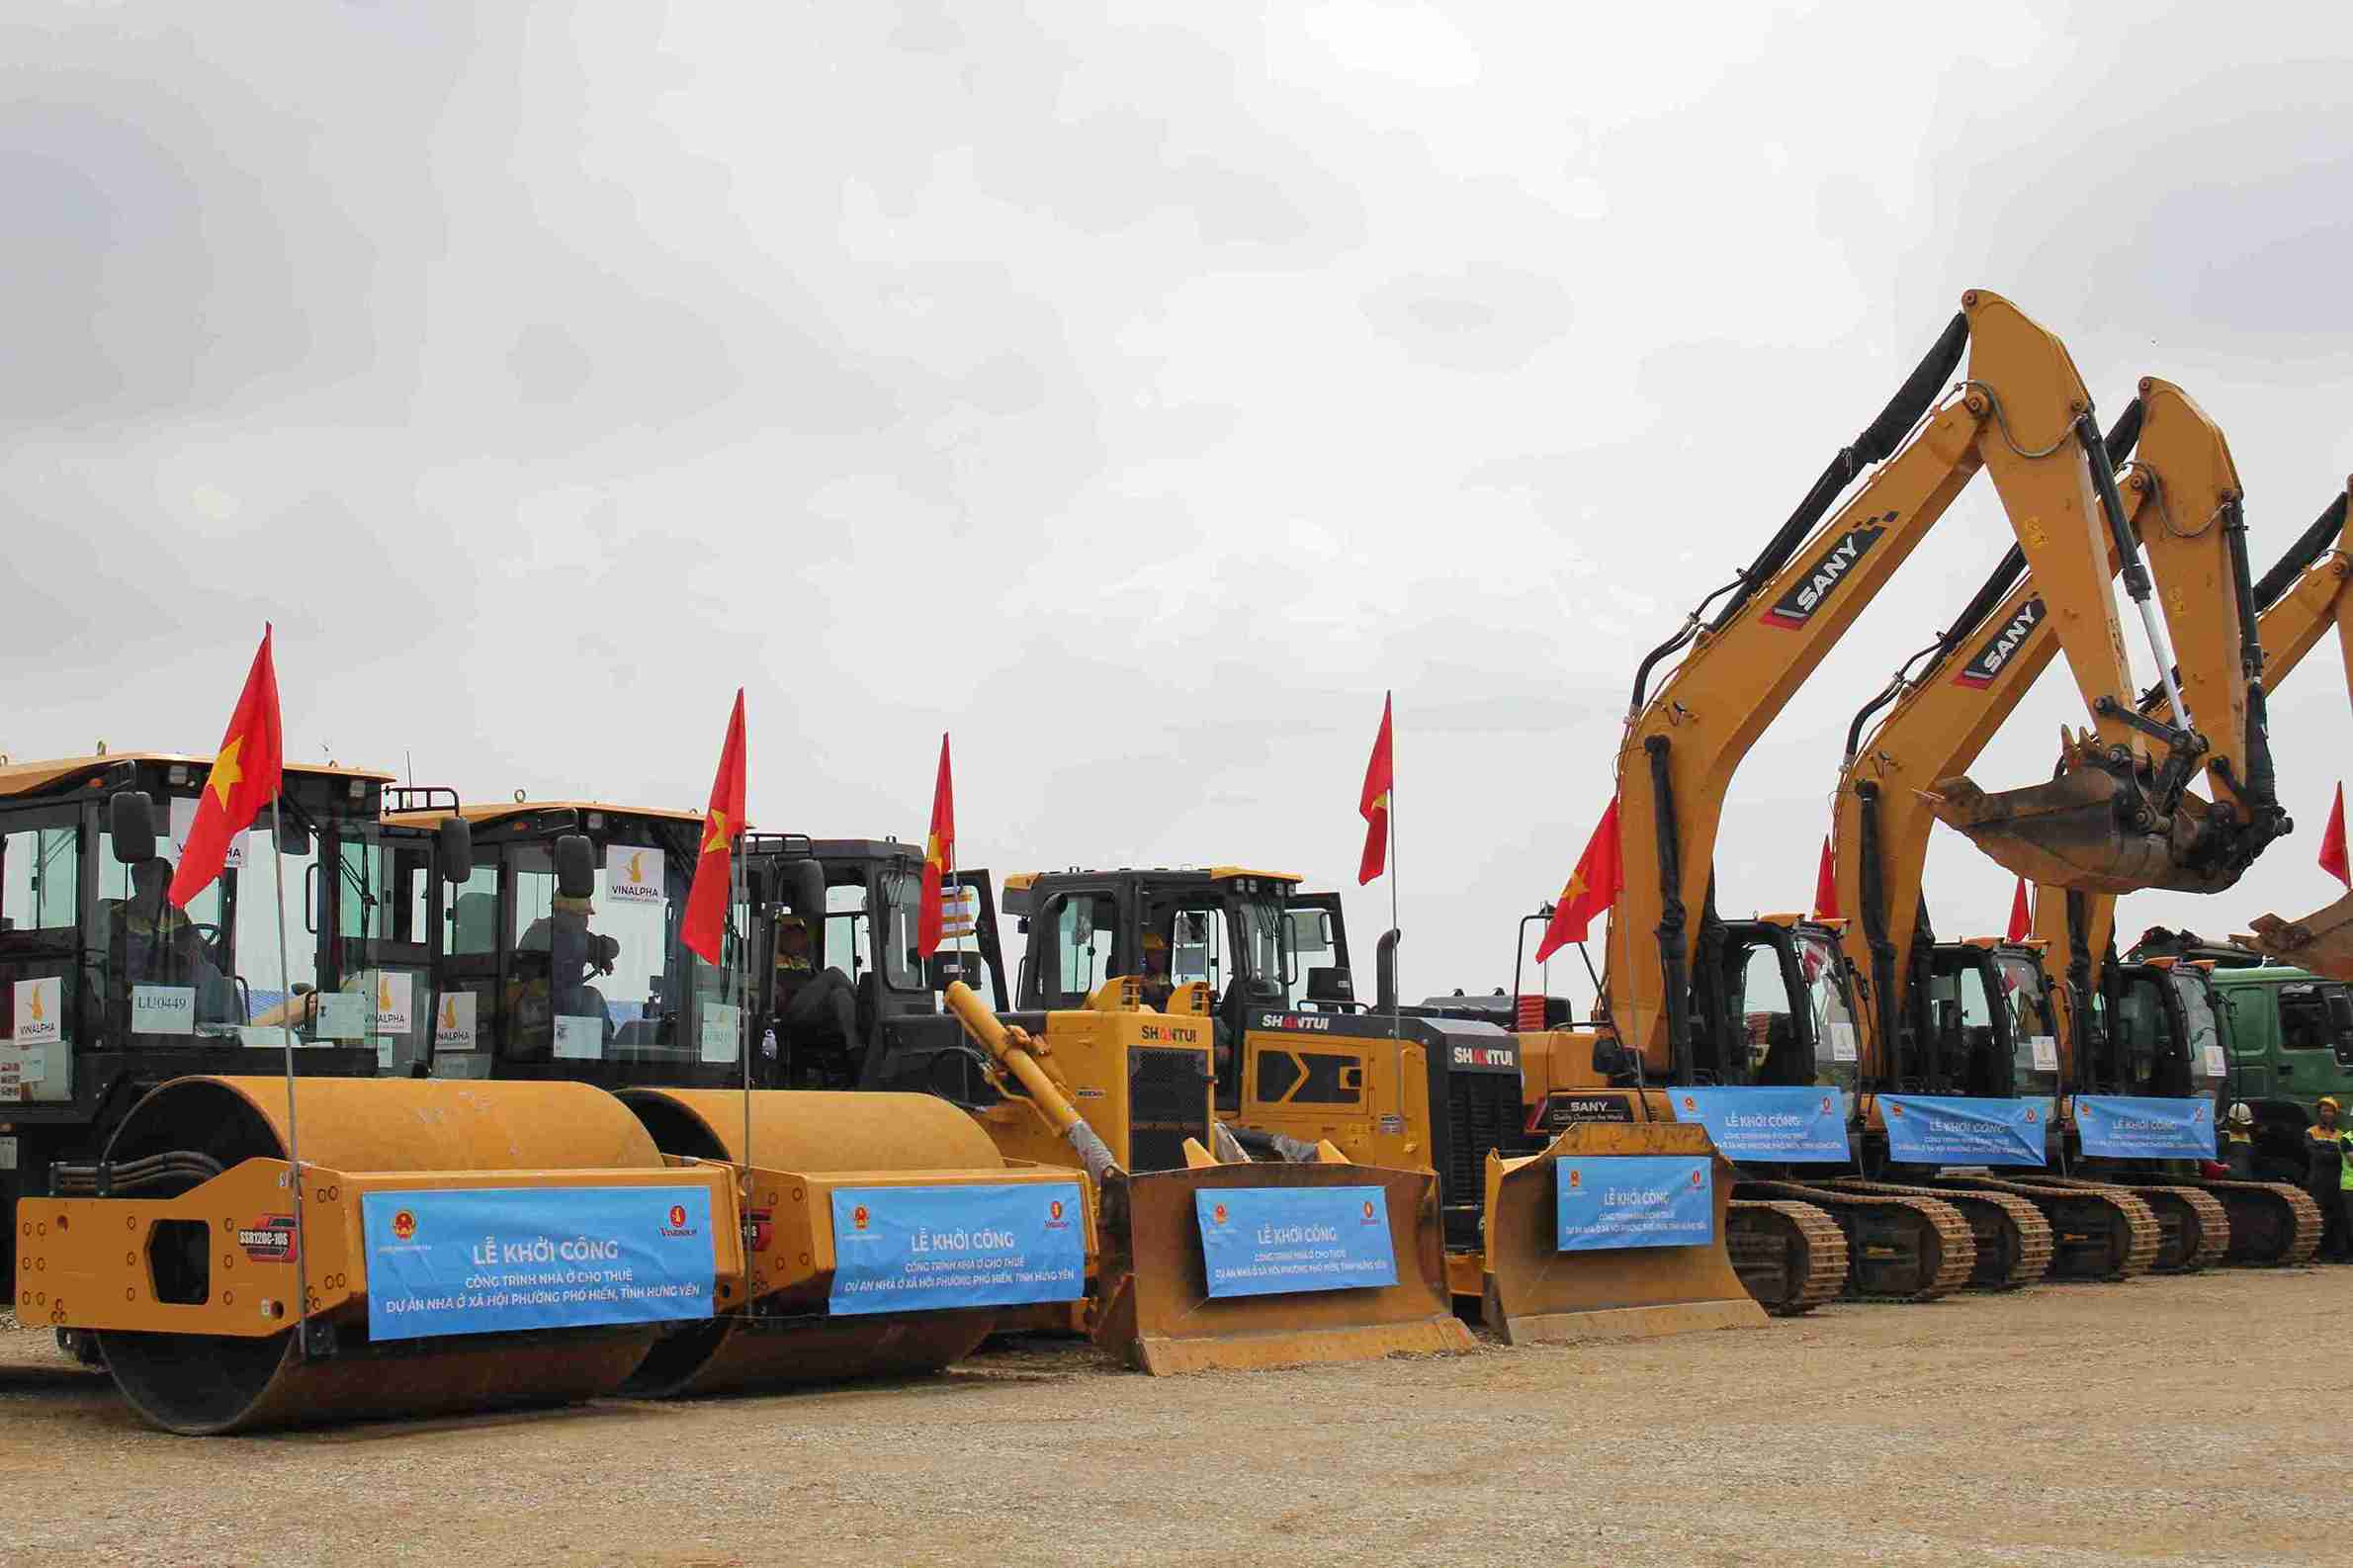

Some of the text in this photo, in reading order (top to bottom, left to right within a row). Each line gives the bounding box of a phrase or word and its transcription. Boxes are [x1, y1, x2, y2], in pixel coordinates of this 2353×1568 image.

[1796, 535, 1859, 611] SANY
[1983, 603, 2037, 672] SANY
[612, 886, 658, 897] VINALPHA
[1262, 1014, 1330, 1030] SHANTUI
[1142, 1025, 1197, 1043] SHANTUI
[1454, 1047, 1513, 1067] SHANTUI
[1571, 1101, 1608, 1112] SANY
[973, 1227, 1013, 1250] CÔNG
[474, 1235, 619, 1264] LỄ KHỞI CÔNG
[466, 1274, 499, 1288] CÔNG
[577, 1271, 602, 1283] CHO
[603, 1266, 633, 1282] THUÊ
